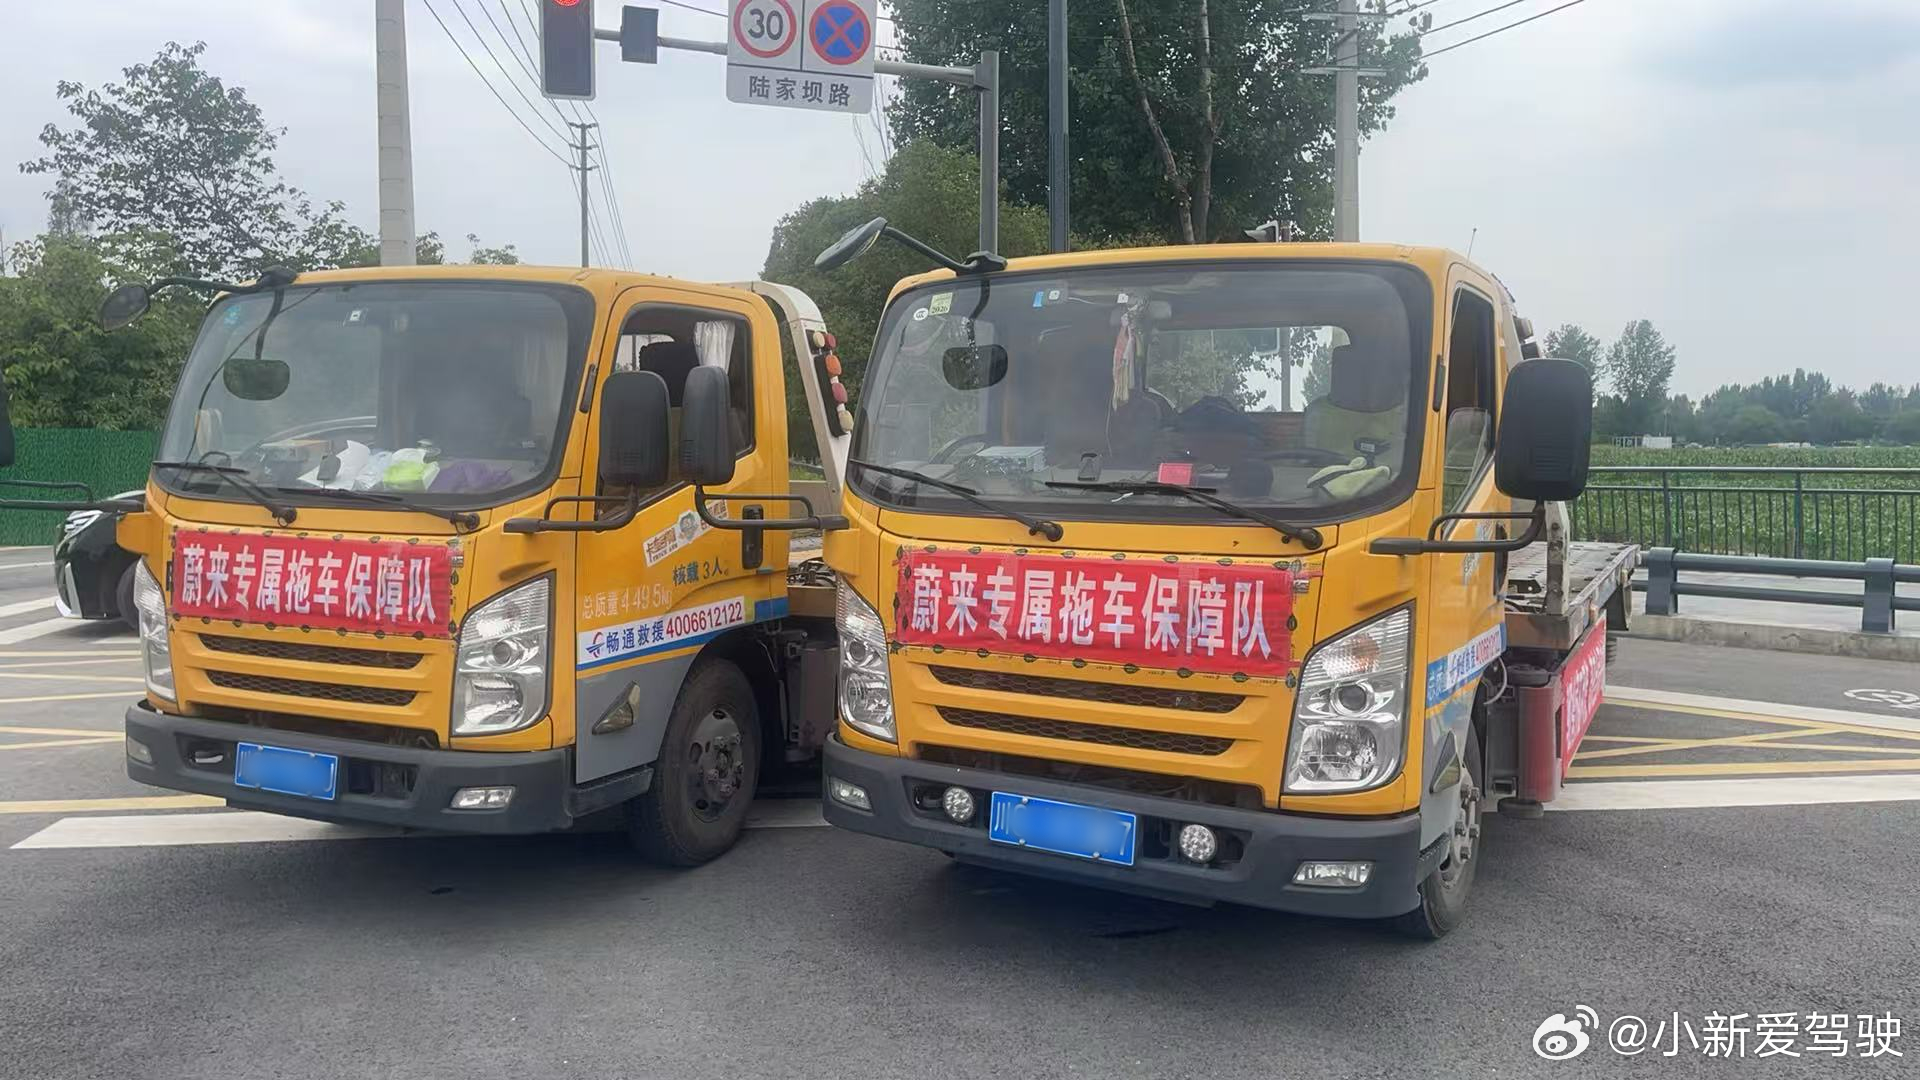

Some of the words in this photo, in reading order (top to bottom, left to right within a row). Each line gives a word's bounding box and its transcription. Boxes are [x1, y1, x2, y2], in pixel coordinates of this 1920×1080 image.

[748, 8, 784, 41] 30
[749, 75, 851, 107] 陆家坝路
[182, 543, 437, 624] 蔚来专属拖车保障队
[911, 562, 1273, 660] 蔚来专属拖车保障队
